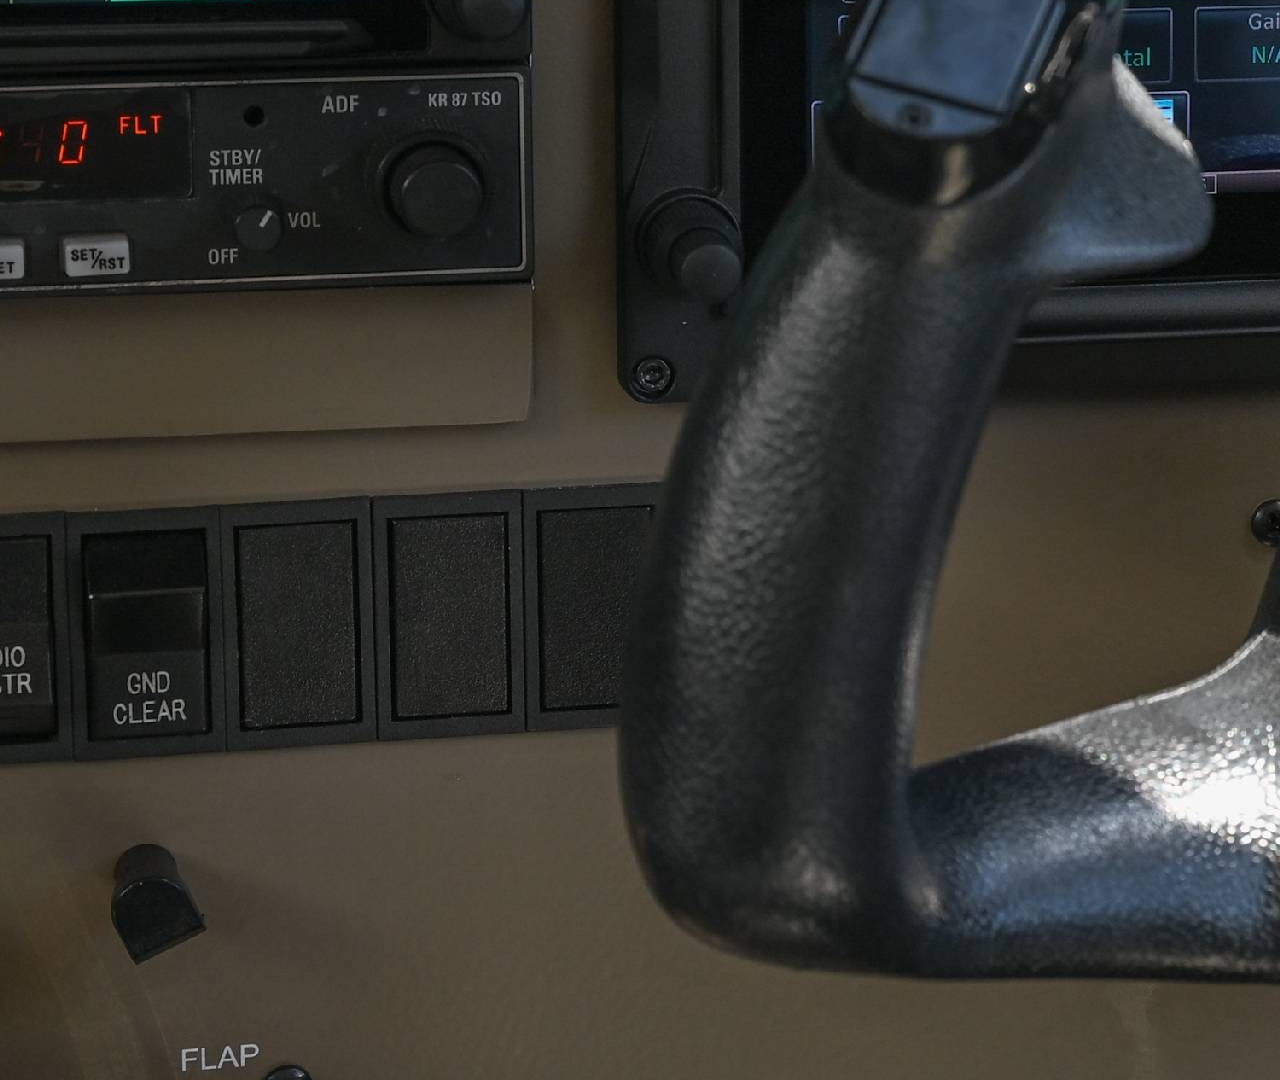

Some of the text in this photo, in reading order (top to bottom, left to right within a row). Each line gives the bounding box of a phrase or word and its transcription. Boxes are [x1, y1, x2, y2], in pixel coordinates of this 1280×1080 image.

[321, 96, 359, 114] ADF
[428, 92, 501, 107] KR 87 TSO
[119, 116, 162, 134] FLT
[209, 150, 261, 167] STBY/
[209, 168, 263, 185] TIMER
[288, 212, 321, 228] VOL
[209, 248, 239, 265] OFF
[127, 671, 170, 694] GND
[113, 699, 187, 724] CLEAR
[180, 1044, 259, 1071] FLAP
